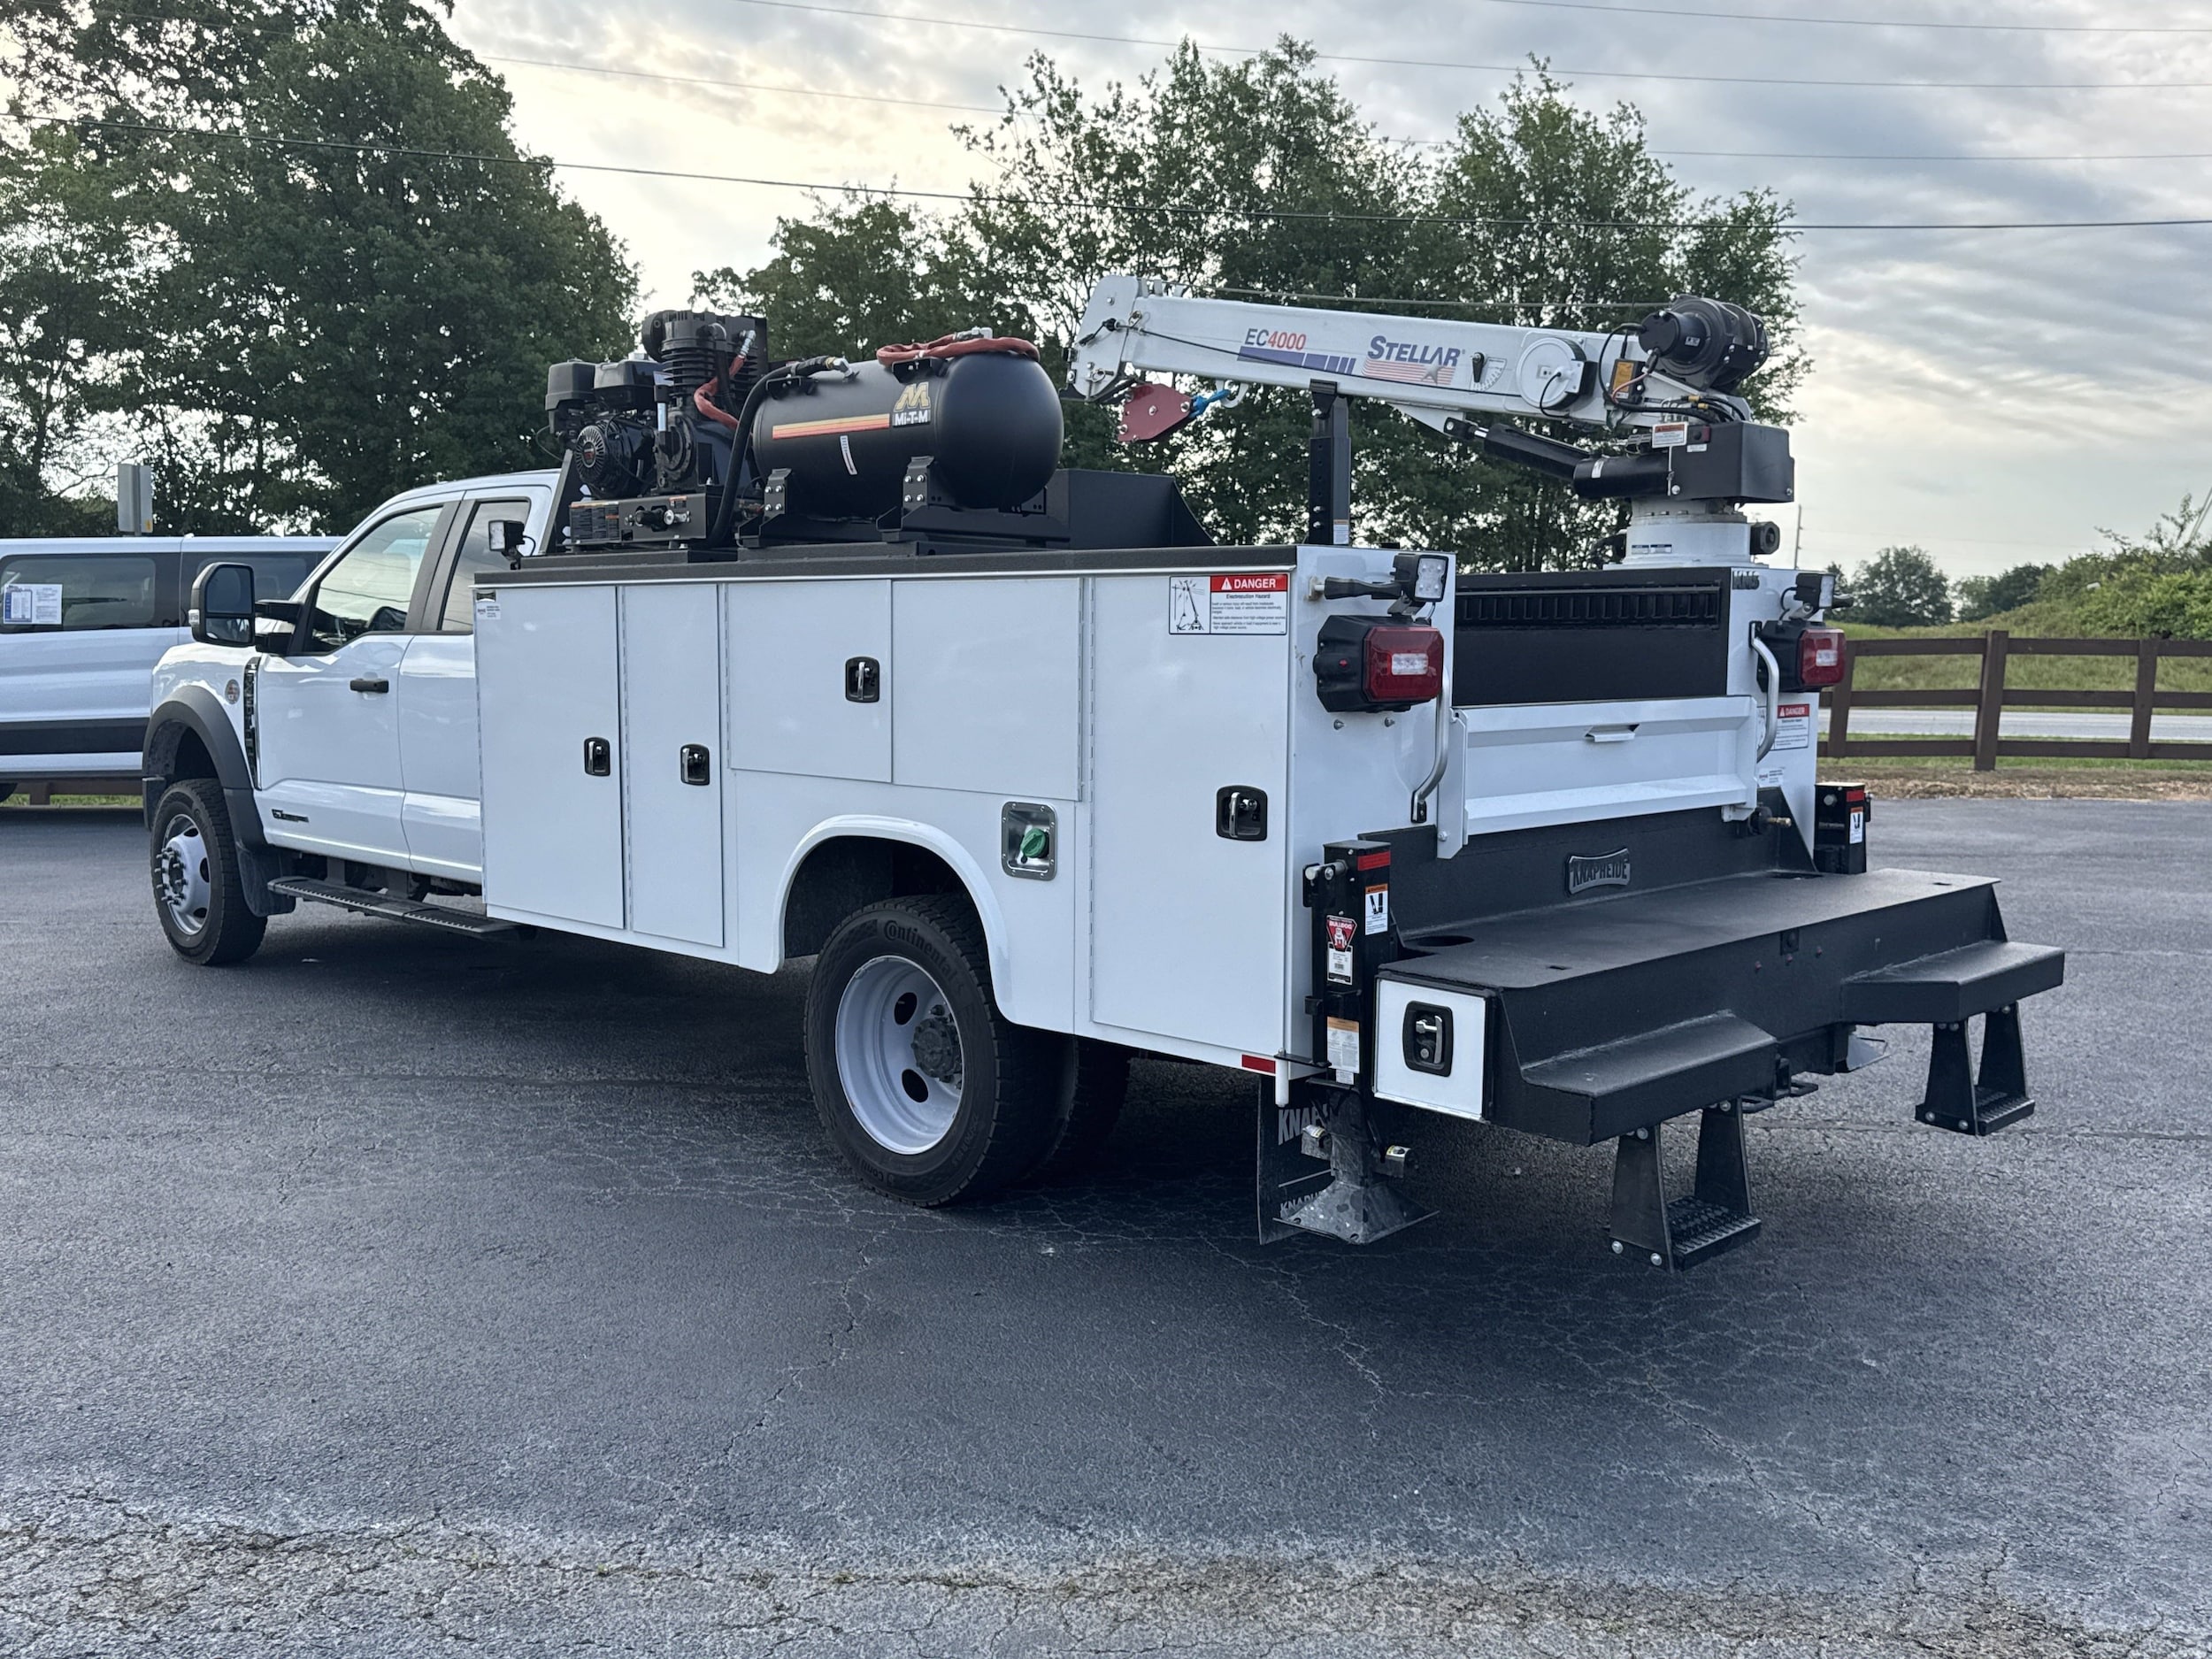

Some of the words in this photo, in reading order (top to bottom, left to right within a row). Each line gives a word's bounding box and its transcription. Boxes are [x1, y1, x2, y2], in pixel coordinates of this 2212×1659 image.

[1244, 327, 1307, 350] EC4000
[1367, 335, 1461, 367] STELLAR
[1233, 578, 1277, 589] DANGER
[1572, 860, 1628, 887] KNAPHEIDE
[1328, 920, 1353, 930] BULLDOG
[1279, 1104, 1328, 1146] KNAP
